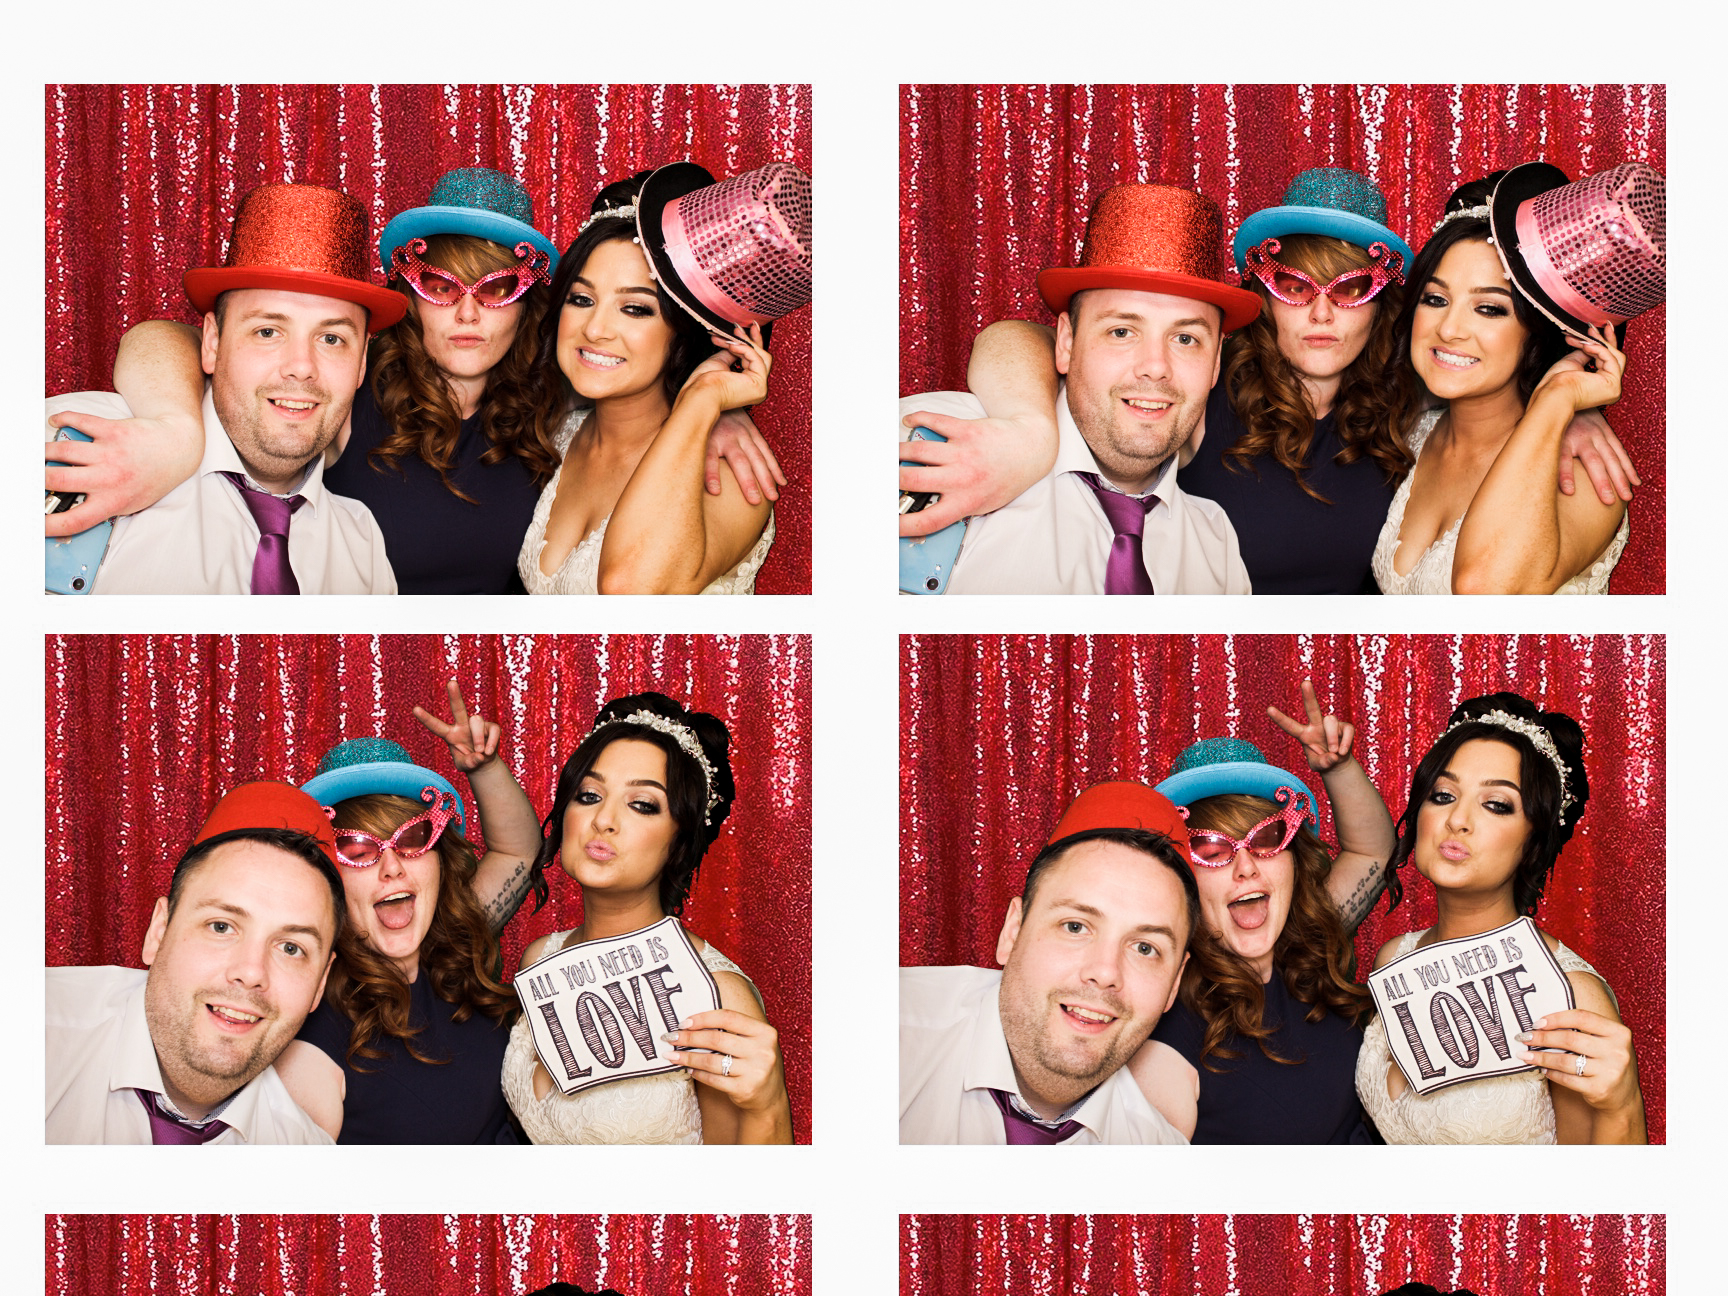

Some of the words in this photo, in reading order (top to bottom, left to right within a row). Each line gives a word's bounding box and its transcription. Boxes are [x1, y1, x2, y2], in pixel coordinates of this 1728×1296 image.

[529, 972, 560, 1001] ALL
[560, 959, 597, 990] YOU
[598, 944, 643, 979] NEED
[647, 936, 669, 963] IS
[1383, 972, 1414, 1001] ALL
[1414, 959, 1451, 990] YOU
[1452, 944, 1497, 979] NEED
[1501, 936, 1523, 963] IS
